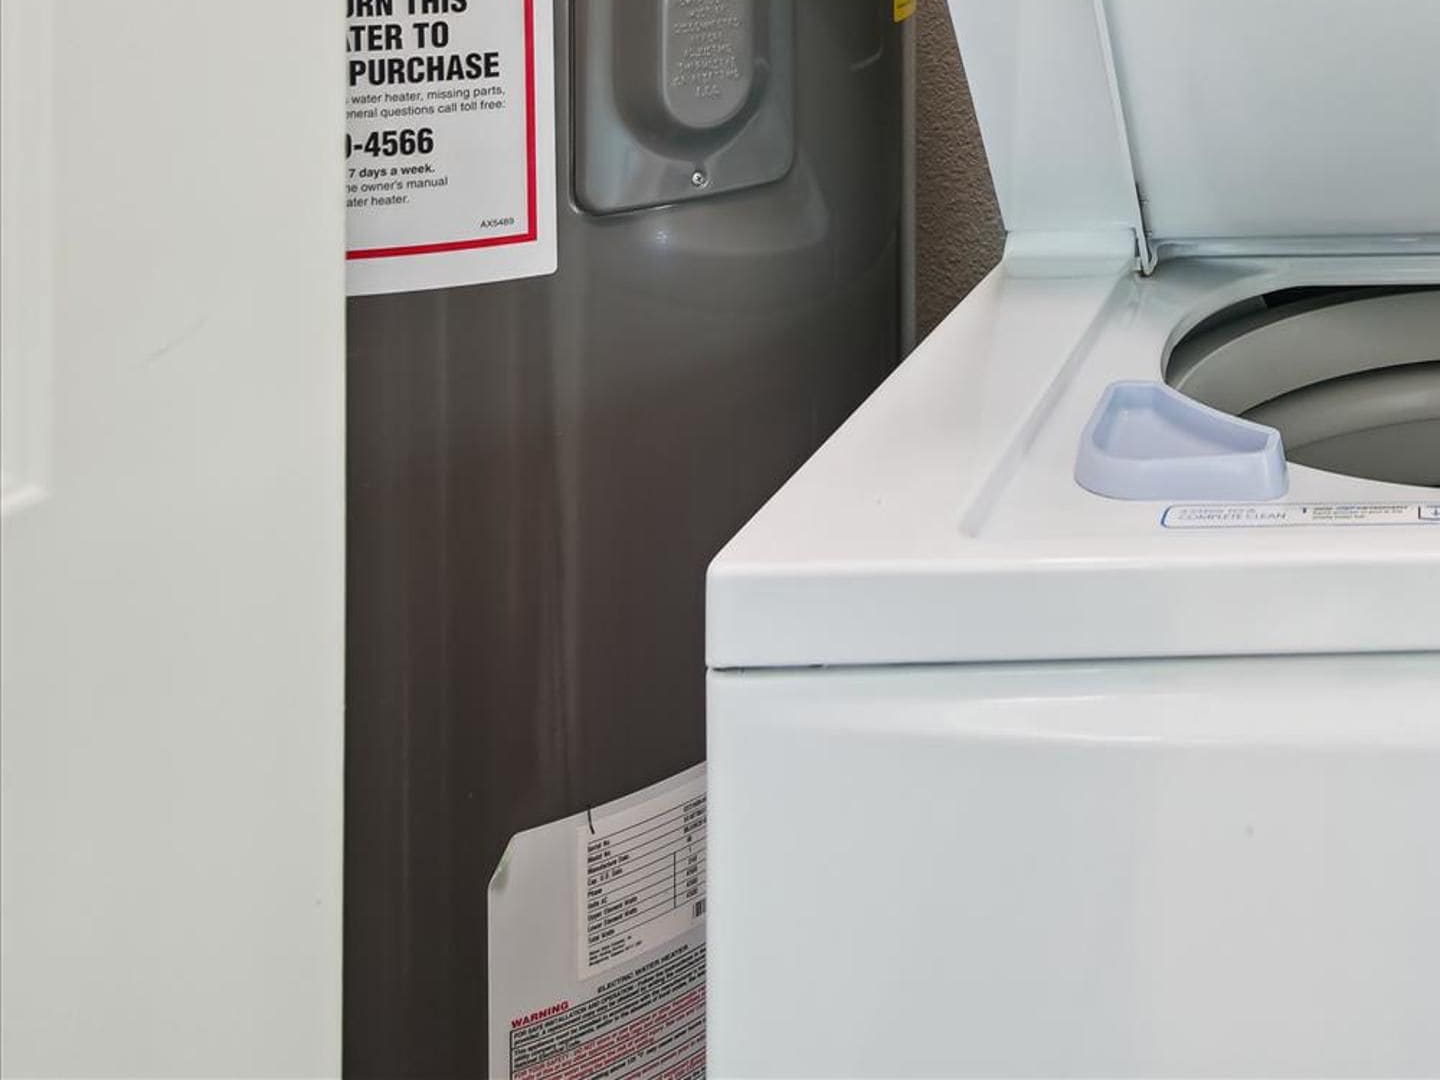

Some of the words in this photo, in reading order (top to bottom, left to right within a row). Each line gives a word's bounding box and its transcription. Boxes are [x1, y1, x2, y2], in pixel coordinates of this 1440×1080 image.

[346, 23, 403, 53] TER
[412, 21, 449, 49] TO
[349, 52, 500, 87] PURCHASE
[351, 93, 382, 105] water
[385, 90, 424, 102] heater,
[427, 88, 470, 101] missing
[472, 85, 506, 98] parts,
[380, 104, 435, 119] questions
[437, 102, 457, 114] call
[460, 100, 477, 112] toll
[480, 98, 506, 110] free:
[349, 168, 356, 178] 7
[359, 167, 387, 180] days
[390, 168, 398, 177] a
[400, 163, 436, 175] week.
[361, 180, 404, 192] owner's
[406, 176, 449, 188] manual
[371, 195, 410, 207] heater.
[511, 1000, 570, 1029] WARNING
